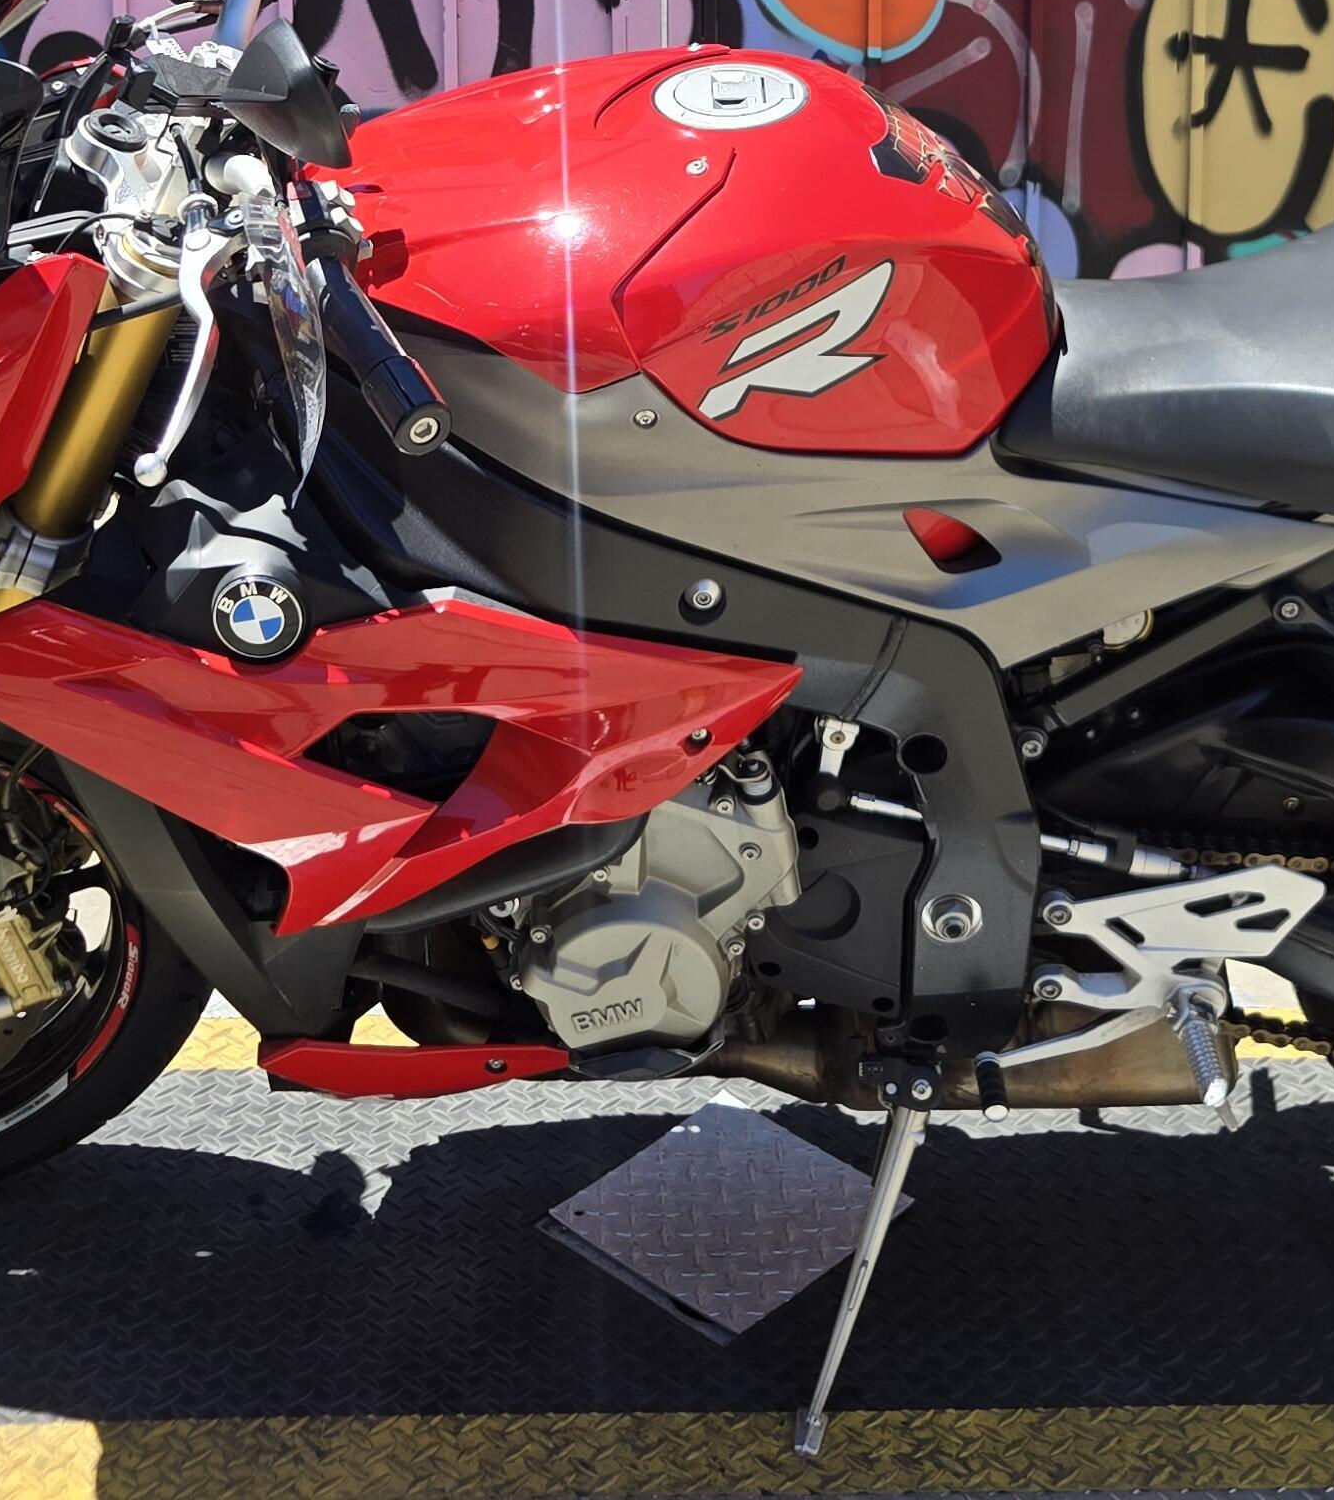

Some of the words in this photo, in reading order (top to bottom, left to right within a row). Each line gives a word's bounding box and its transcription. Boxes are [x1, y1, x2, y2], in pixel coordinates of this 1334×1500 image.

[703, 255, 847, 343] S1000
[697, 257, 896, 422] R
[218, 581, 289, 614] BMW
[117, 941, 139, 1009] S1000R
[571, 997, 643, 1034] BMW
